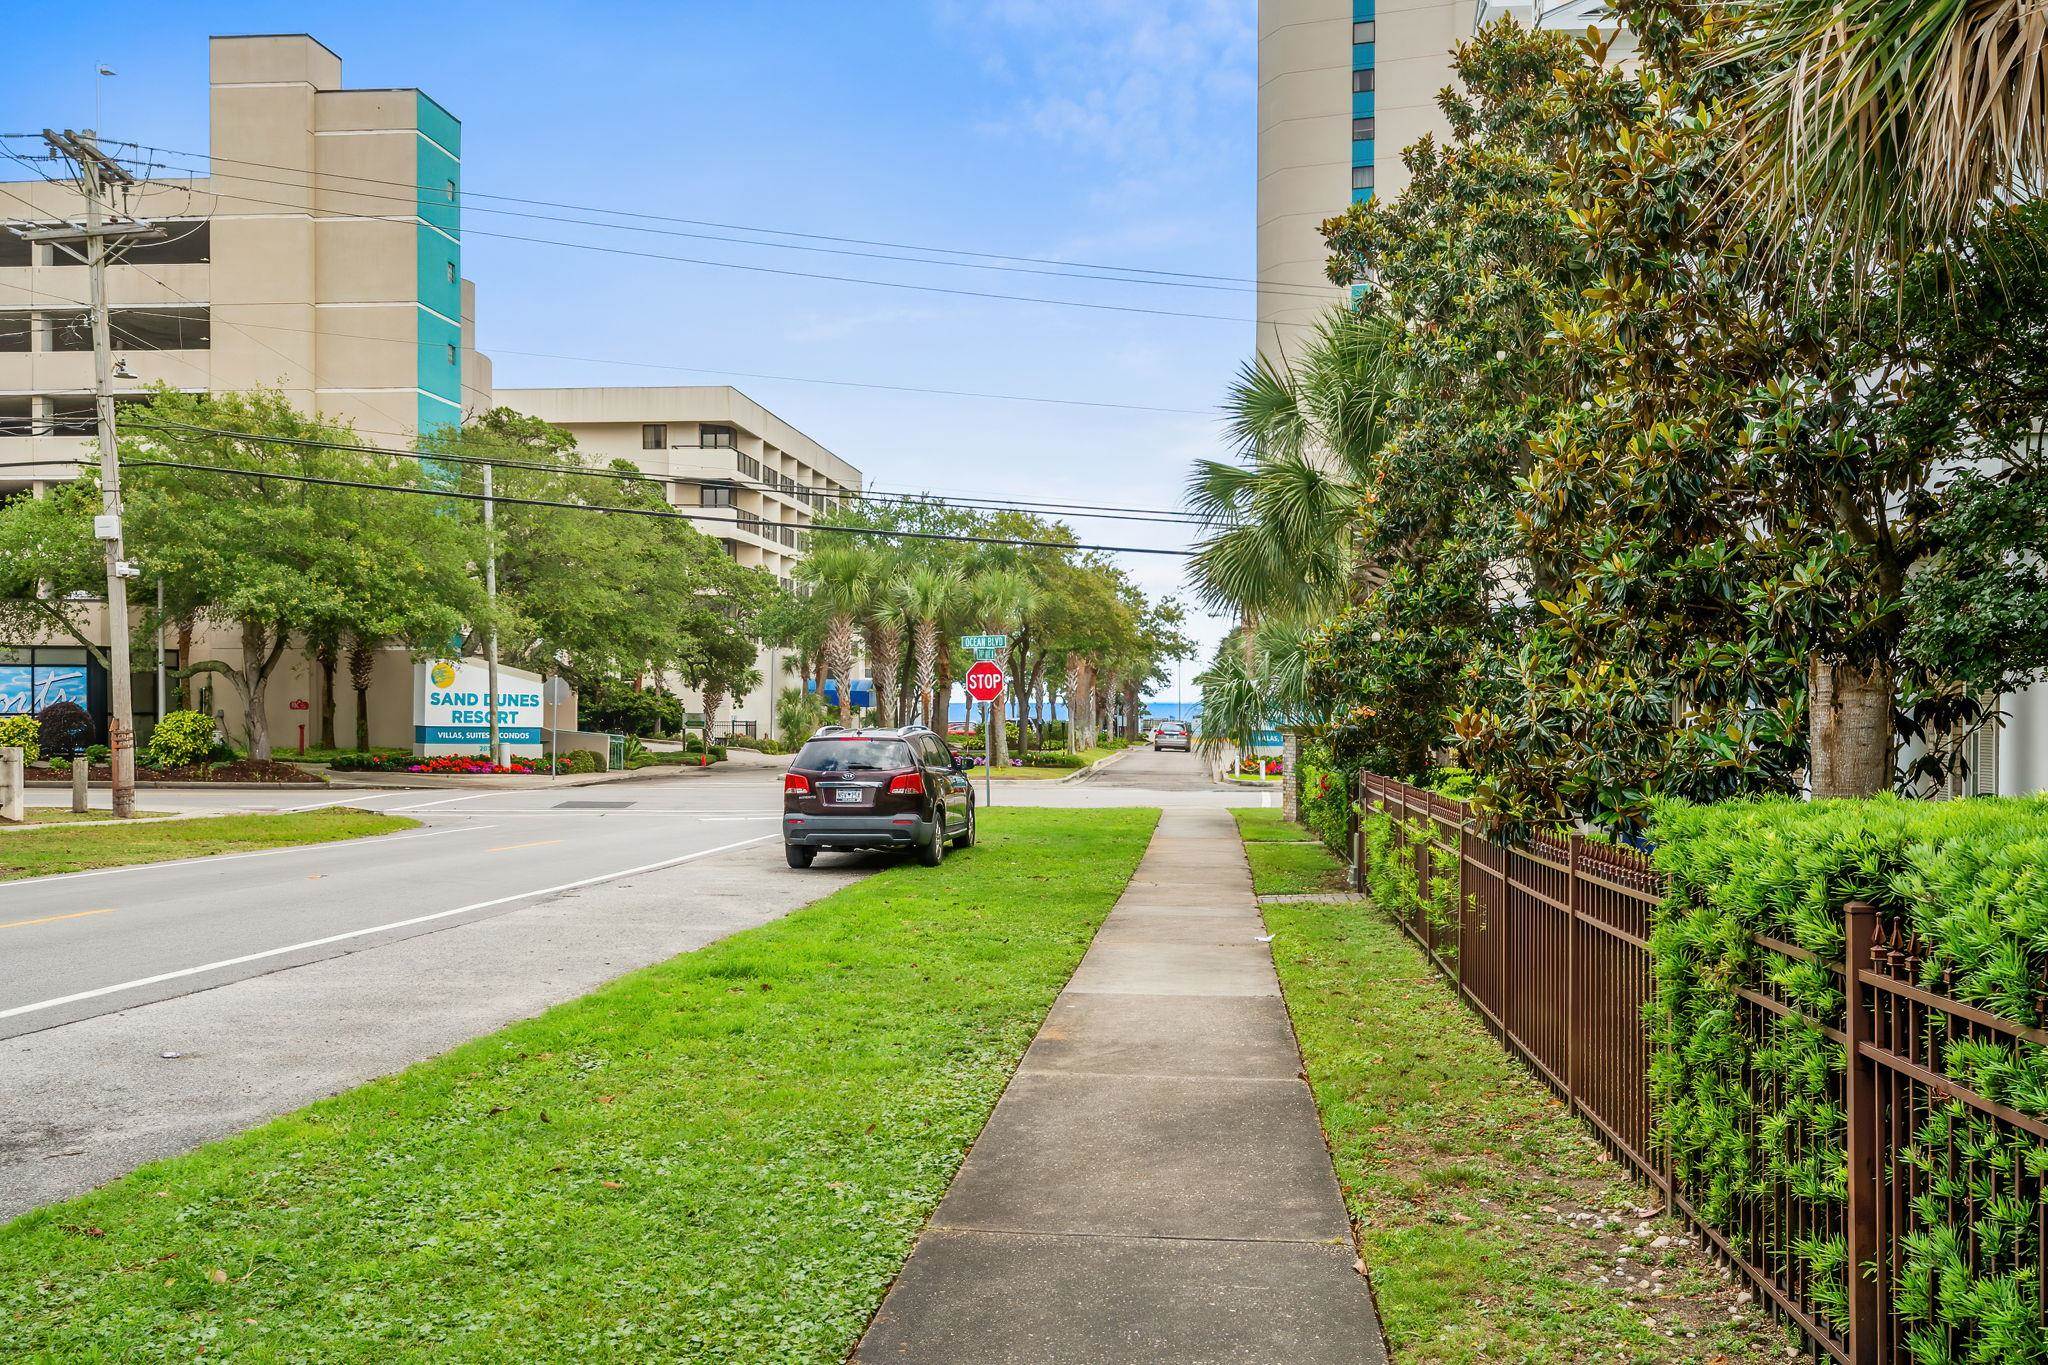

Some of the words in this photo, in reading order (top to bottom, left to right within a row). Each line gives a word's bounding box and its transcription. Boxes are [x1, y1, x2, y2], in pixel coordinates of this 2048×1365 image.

[965, 637, 986, 647] OCEAN
[987, 636, 1003, 646] BLVD
[969, 674, 1001, 689] STOP
[430, 692, 479, 706] SAND
[437, 731, 464, 740] VILLAS,
